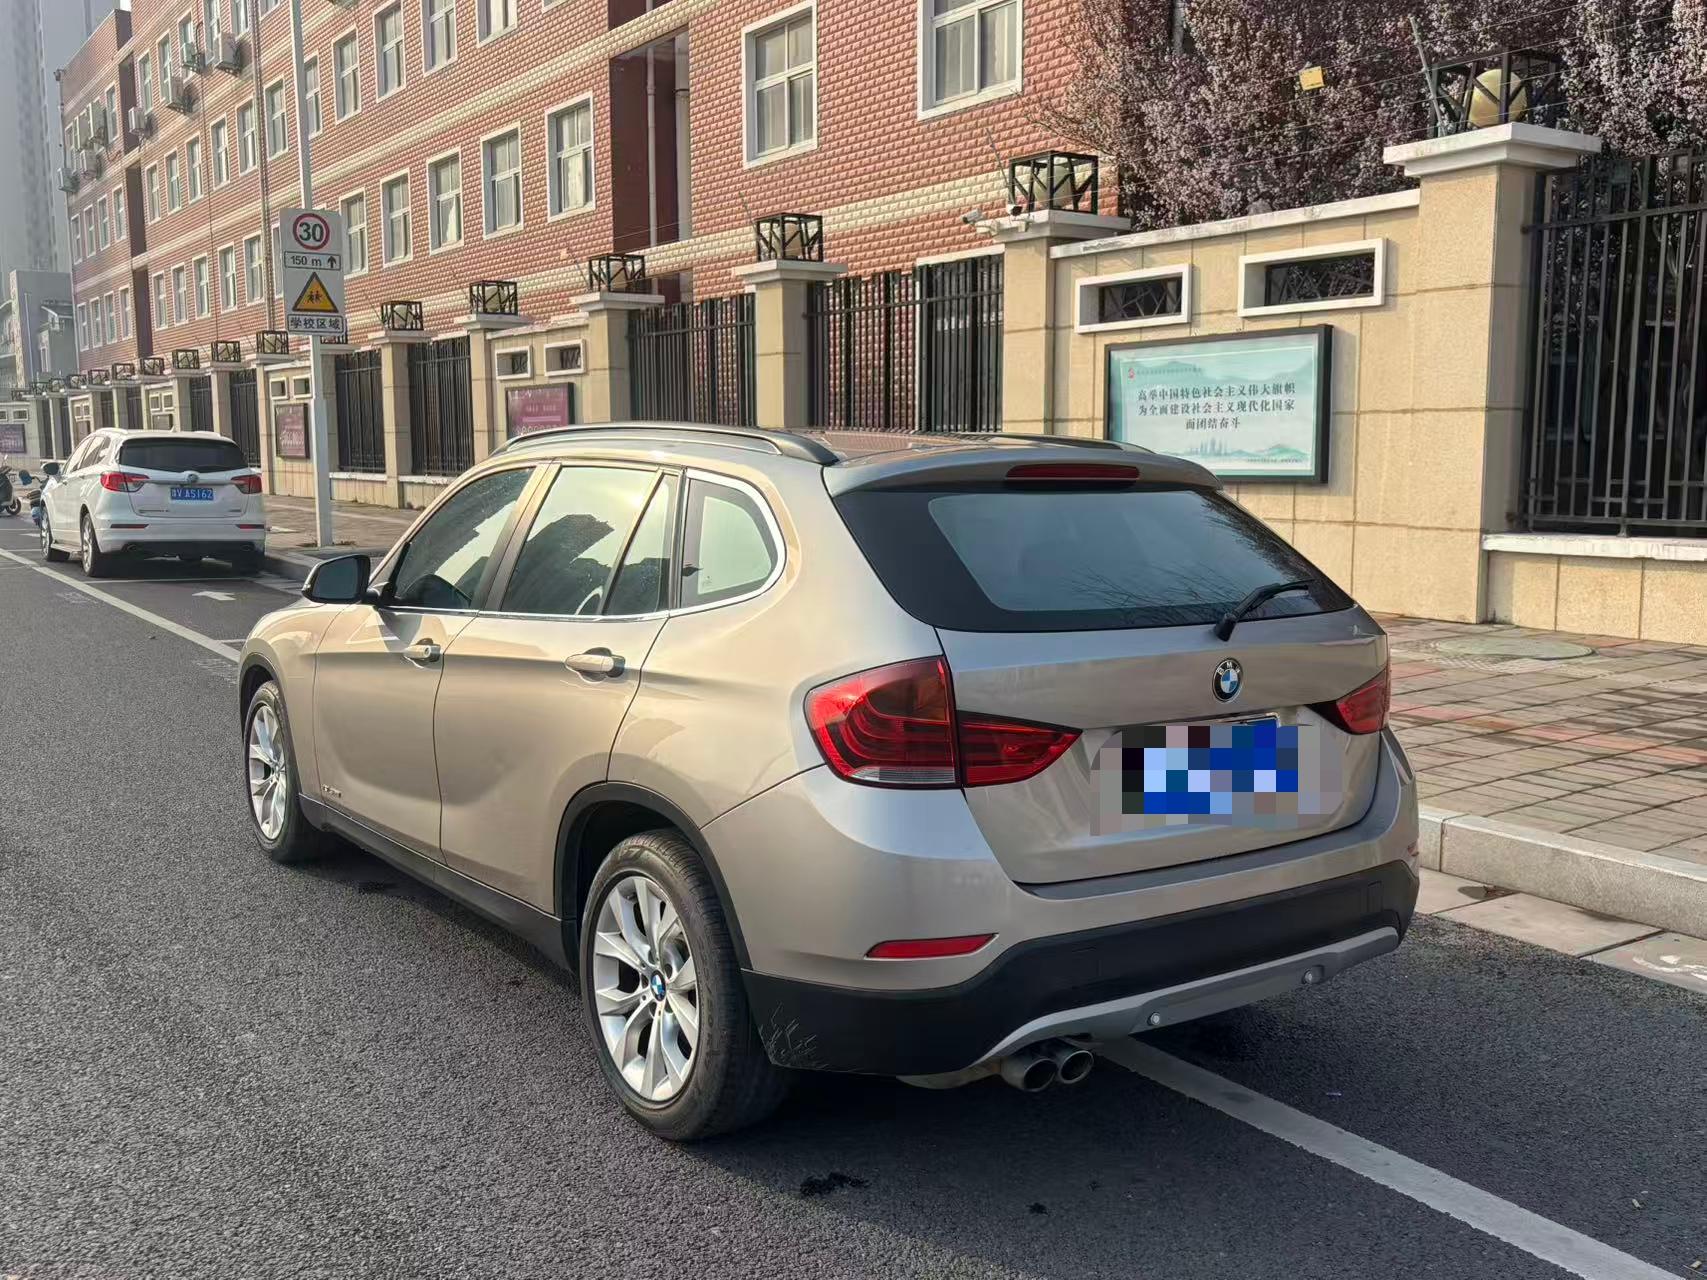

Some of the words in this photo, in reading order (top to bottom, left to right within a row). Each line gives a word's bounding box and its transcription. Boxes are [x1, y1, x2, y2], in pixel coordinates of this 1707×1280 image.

[299, 221, 324, 242] 30
[290, 255, 308, 267] 150
[311, 258, 322, 267] m
[290, 317, 341, 331] 学校区域
[1138, 381, 1296, 401] 高举中国特色社会主义伟大旗帜
[1138, 398, 1296, 416] 为全面建设社会主义现代化国家
[1185, 416, 1241, 430] 面团结奋斗
